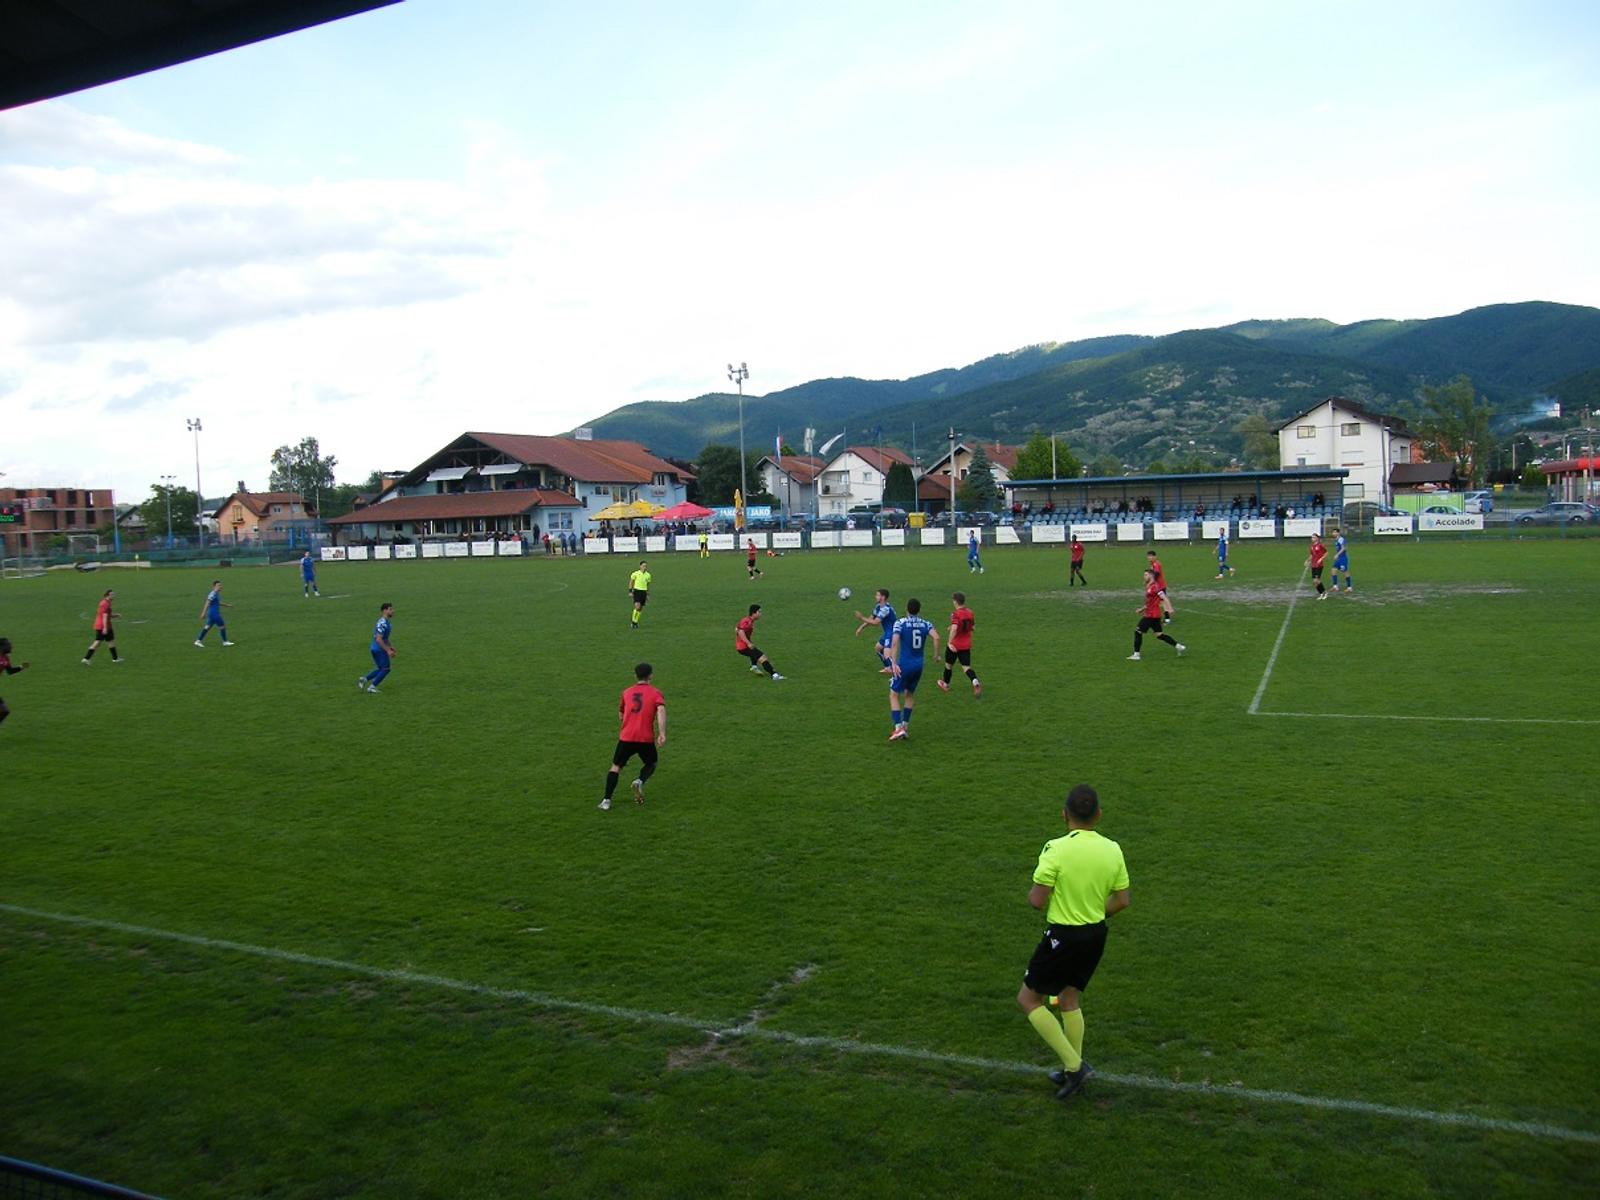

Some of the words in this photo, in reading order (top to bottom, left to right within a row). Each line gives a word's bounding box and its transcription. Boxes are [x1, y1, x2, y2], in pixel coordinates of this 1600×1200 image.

[720, 509, 744, 517] JAK
[751, 508, 771, 517] JAKO
[1435, 518, 1476, 526] Accolade
[912, 629, 922, 649] 6
